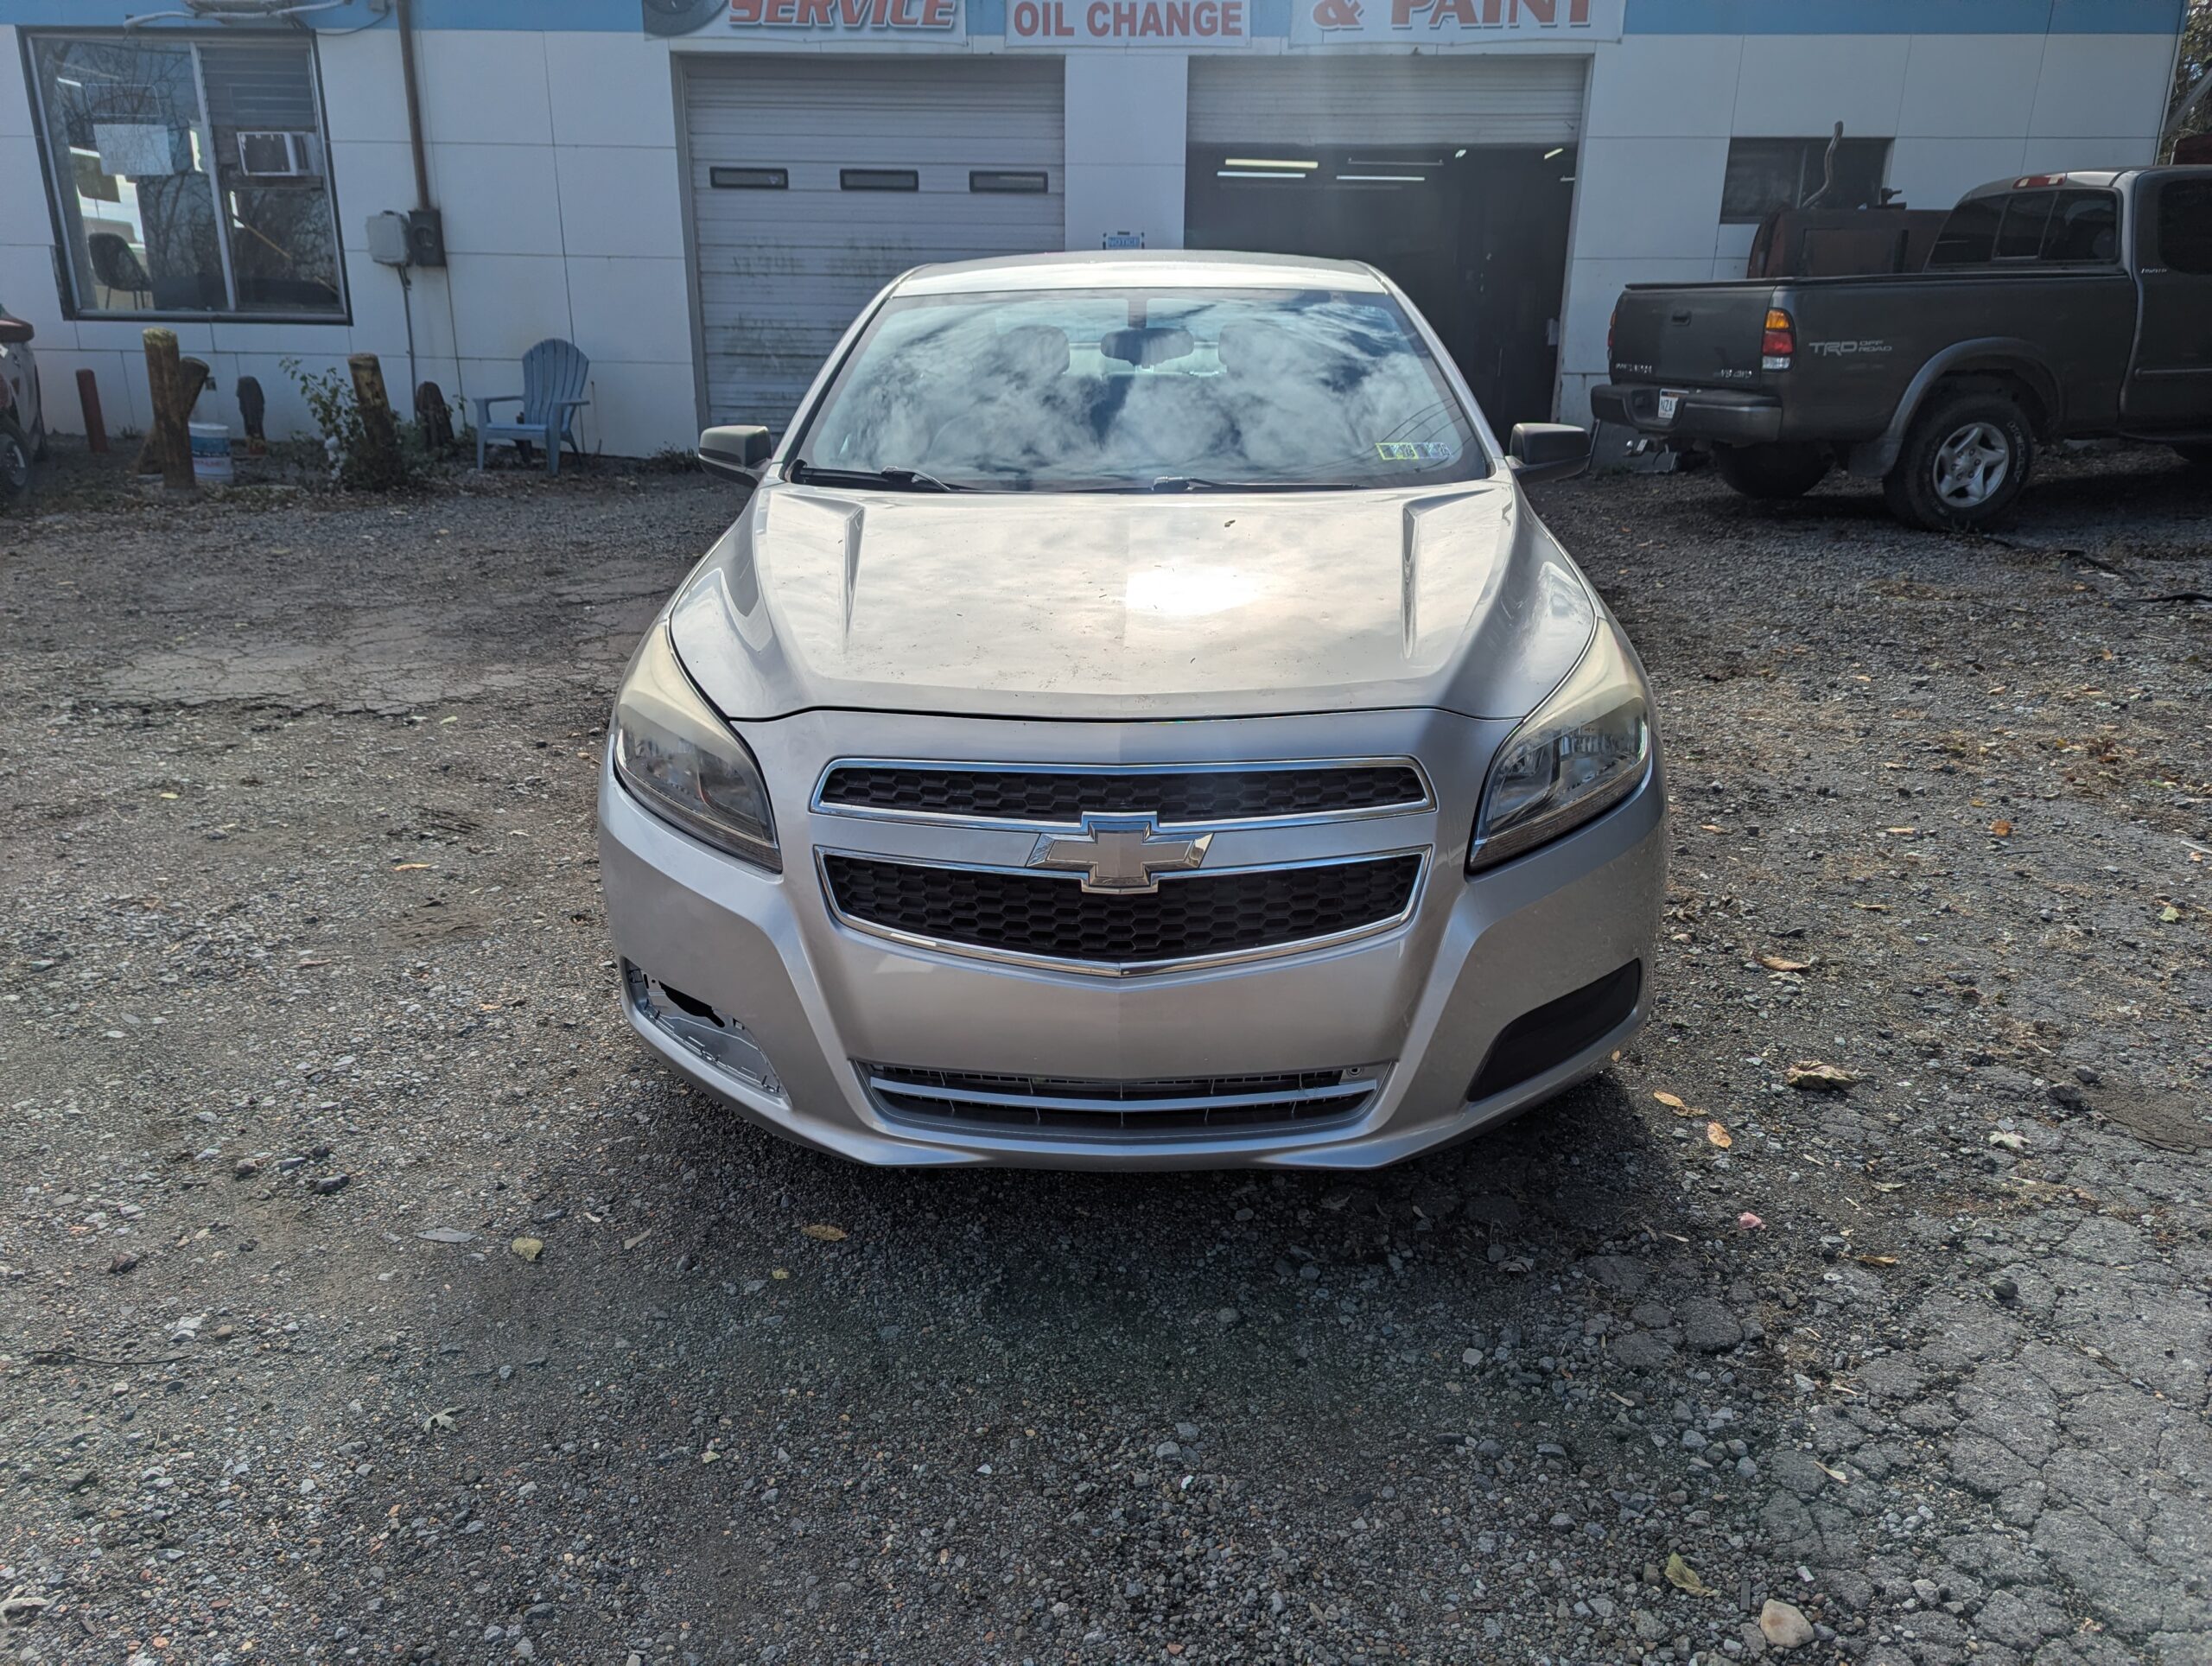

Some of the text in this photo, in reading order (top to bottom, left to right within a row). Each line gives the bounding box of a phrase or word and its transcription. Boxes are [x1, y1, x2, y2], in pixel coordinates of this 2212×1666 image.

[728, 0, 957, 27] SERVICE
[1014, 2, 1243, 36] OIL CHANGE
[1808, 340, 1859, 357] TRD
